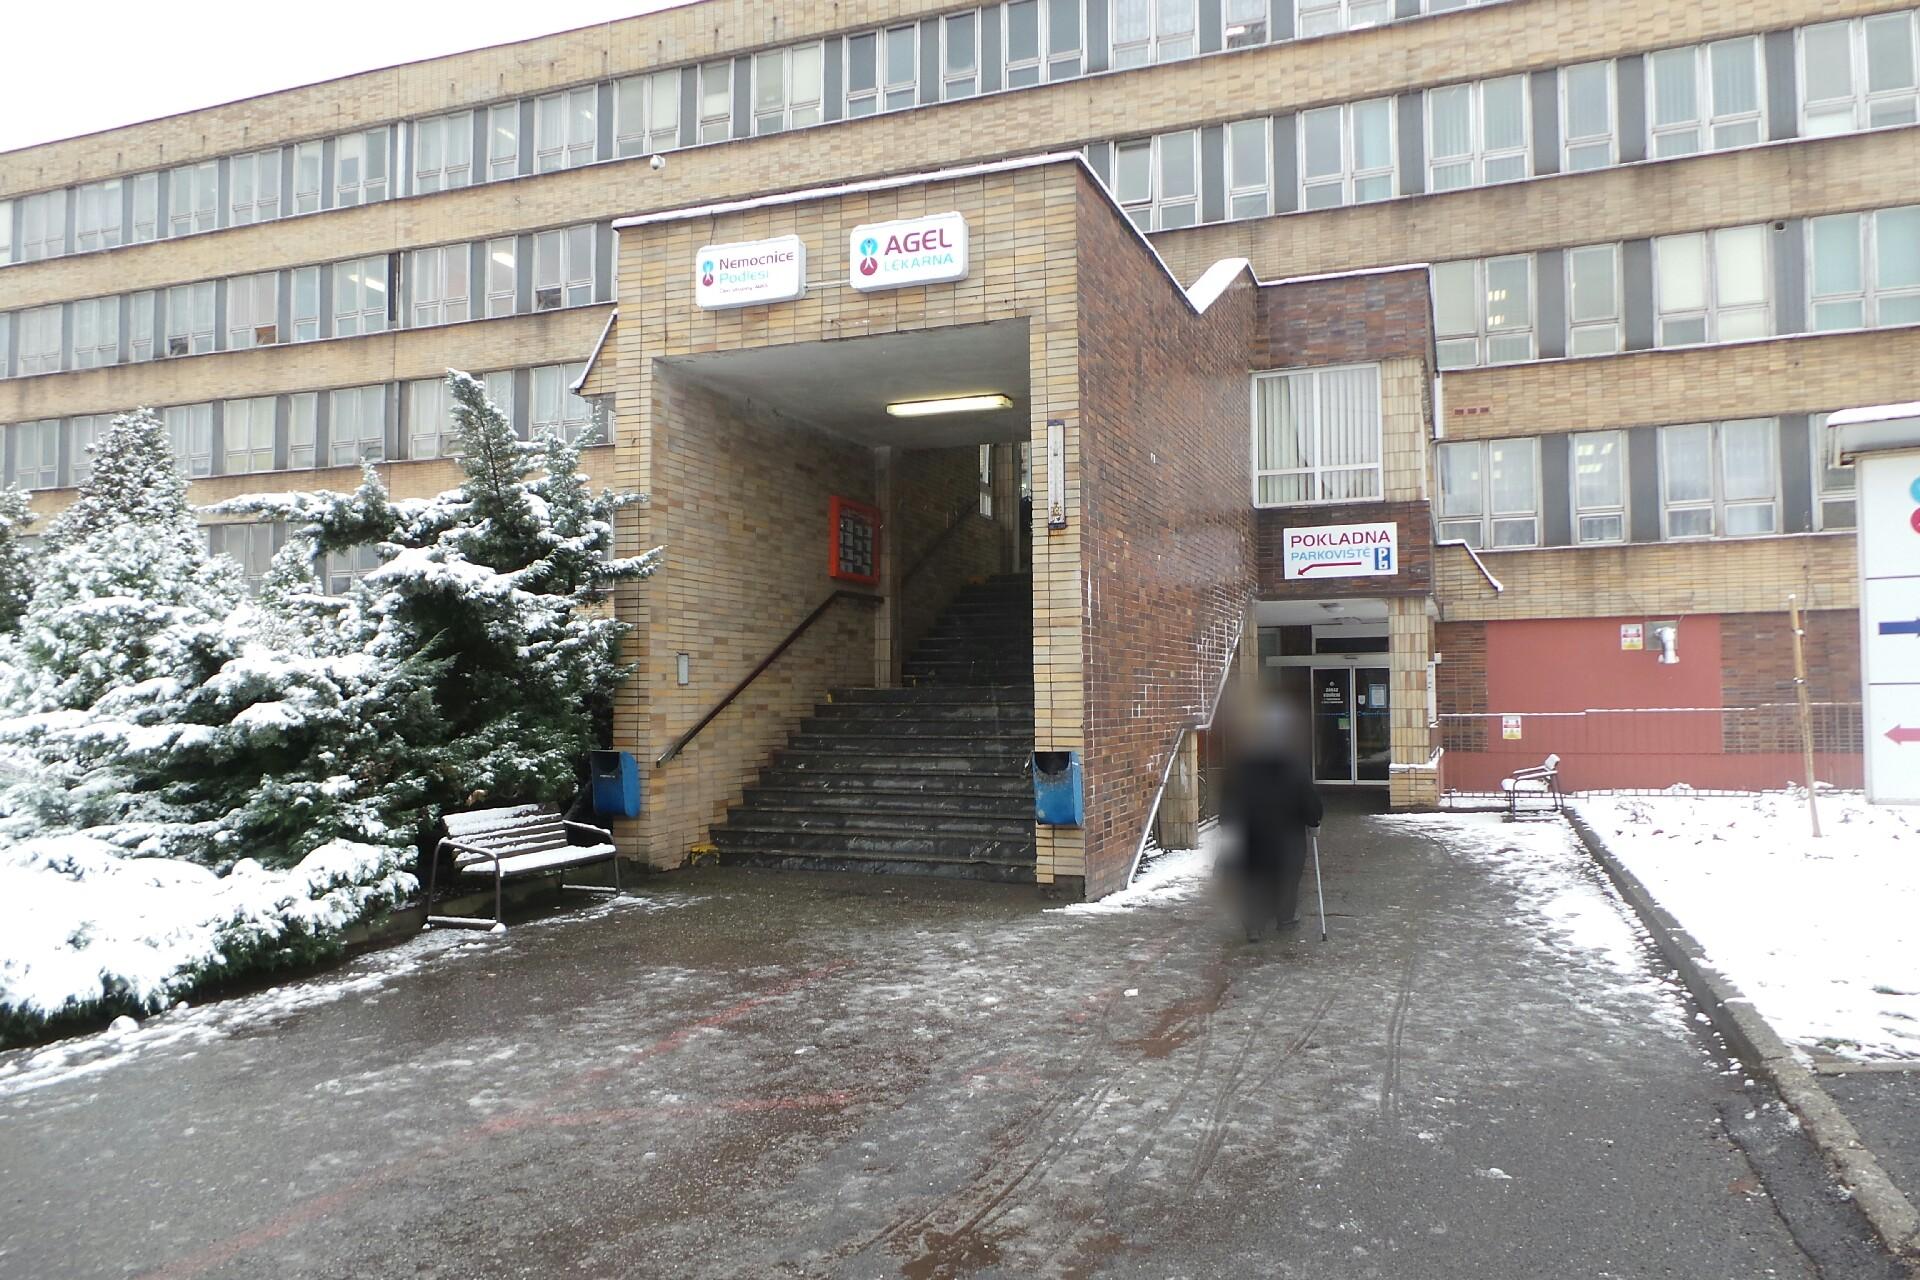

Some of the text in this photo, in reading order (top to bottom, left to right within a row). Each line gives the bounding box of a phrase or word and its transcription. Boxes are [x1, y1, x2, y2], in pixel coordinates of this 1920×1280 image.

[884, 228, 953, 256] AGEL
[719, 251, 794, 270] Nemocnice
[1291, 530, 1391, 548] POKLADNA
